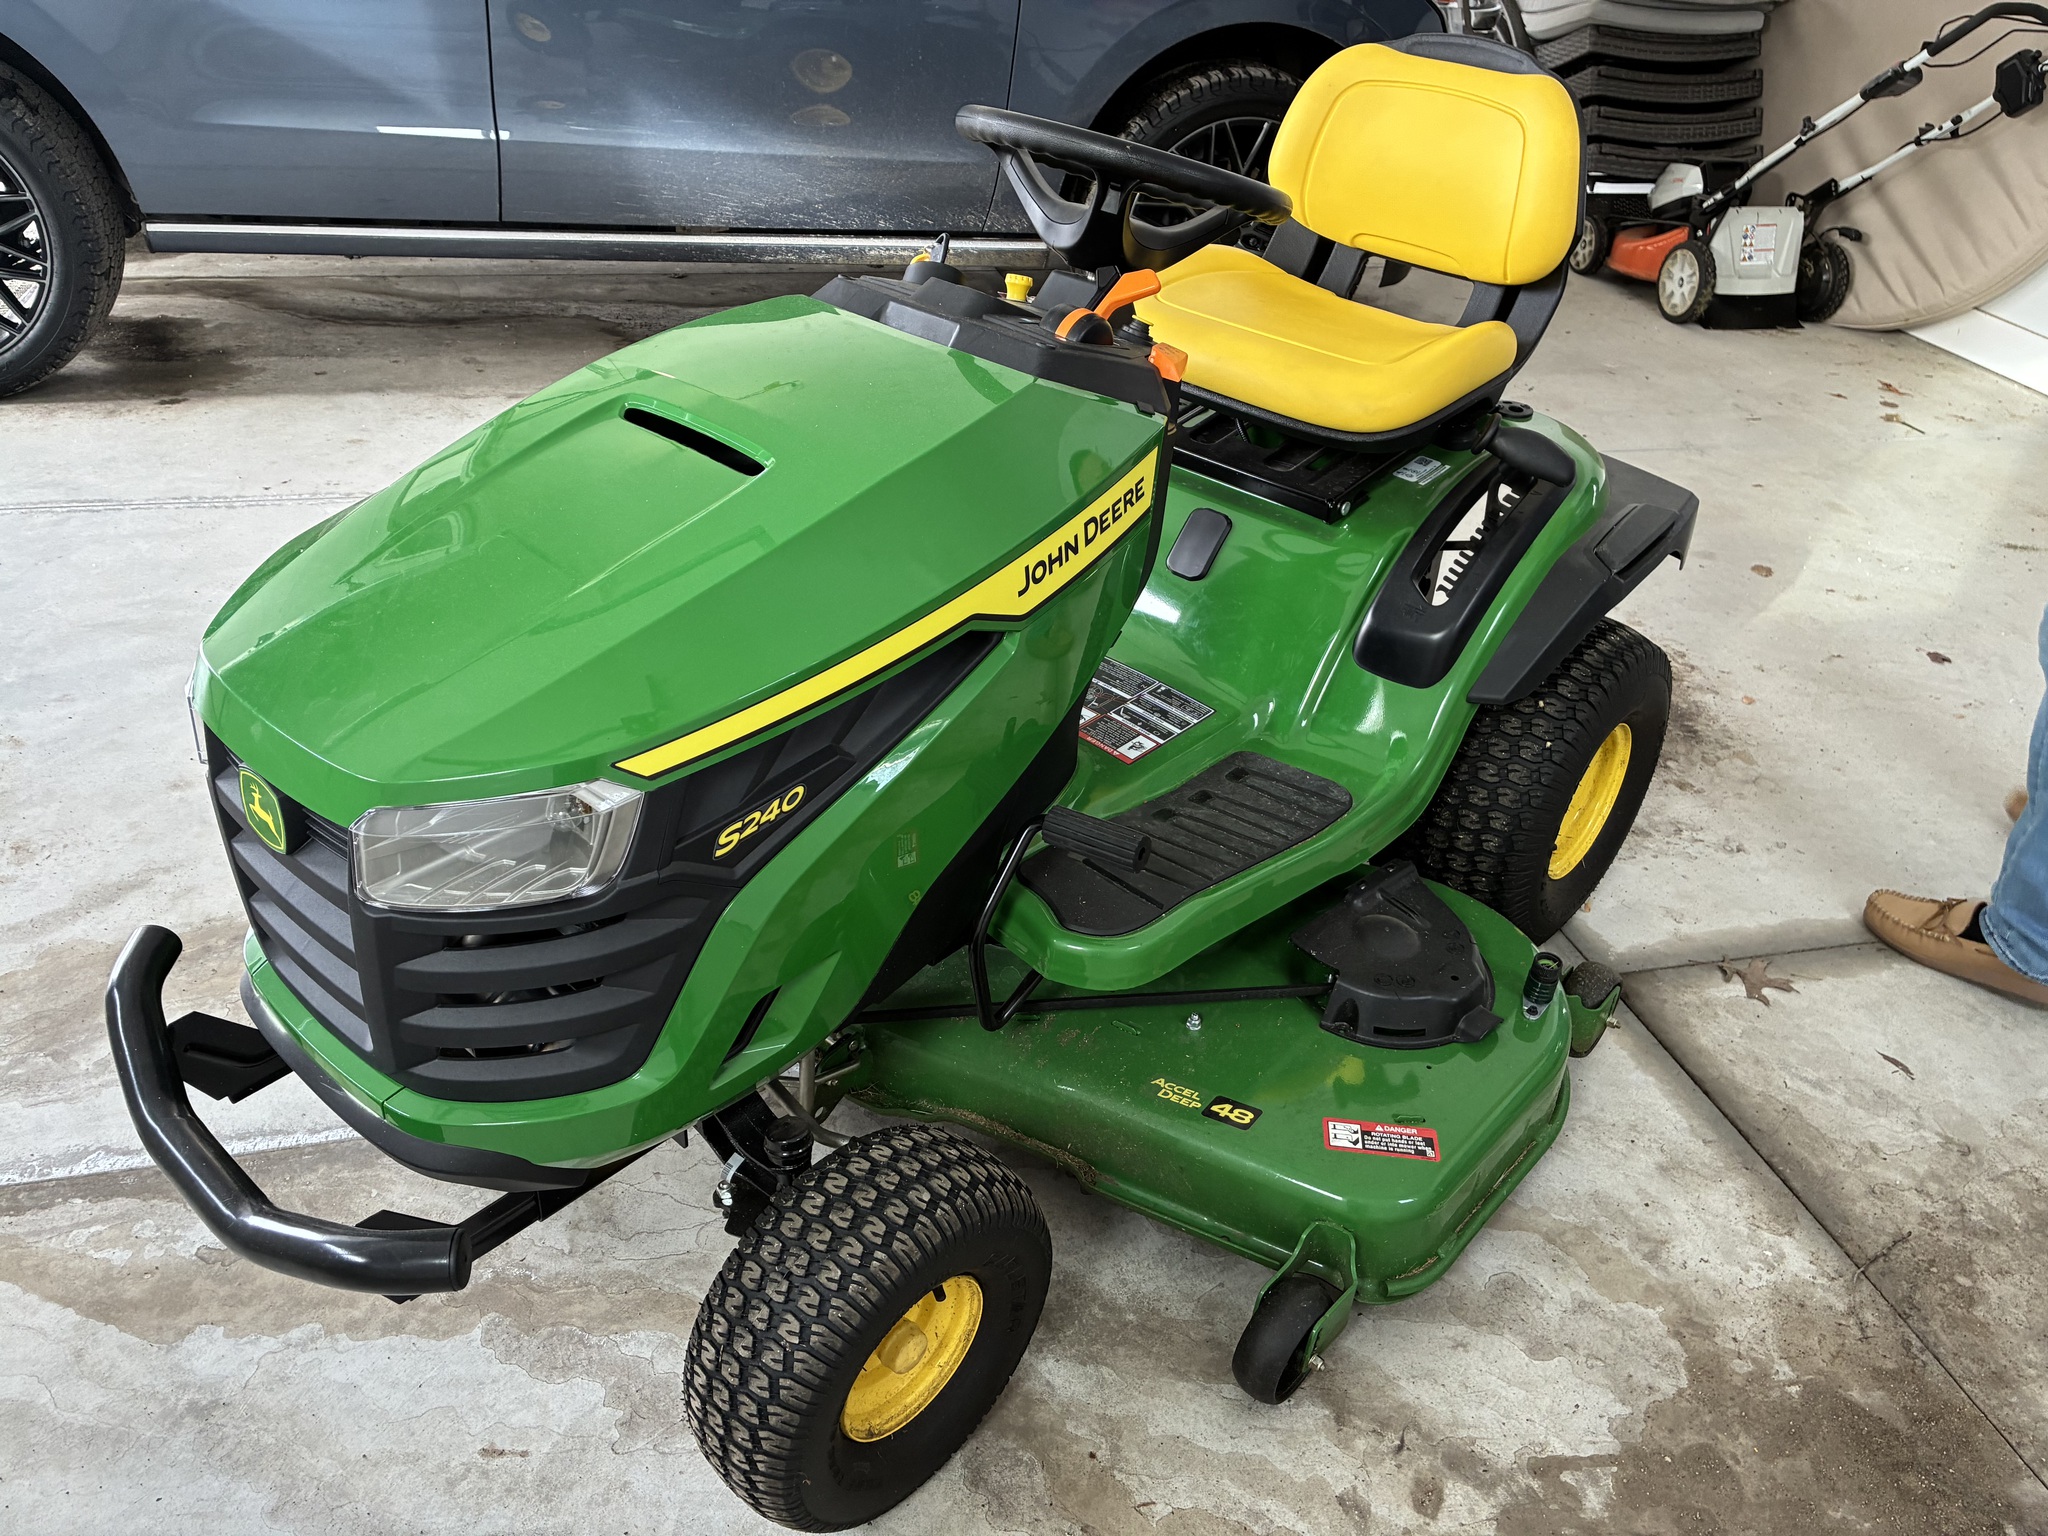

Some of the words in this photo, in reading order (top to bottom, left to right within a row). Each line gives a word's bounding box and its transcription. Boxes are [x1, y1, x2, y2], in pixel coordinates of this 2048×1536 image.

[1018, 533, 1079, 598] JOHN
[1084, 476, 1145, 548] DEERE
[1086, 736, 1114, 753] S240
[1086, 736, 1113, 754] DANGER
[1150, 1077, 1201, 1101] ACCEL
[1157, 1088, 1202, 1109] DEEP
[1209, 1103, 1255, 1124] 48
[1384, 1126, 1418, 1134] DANGER
